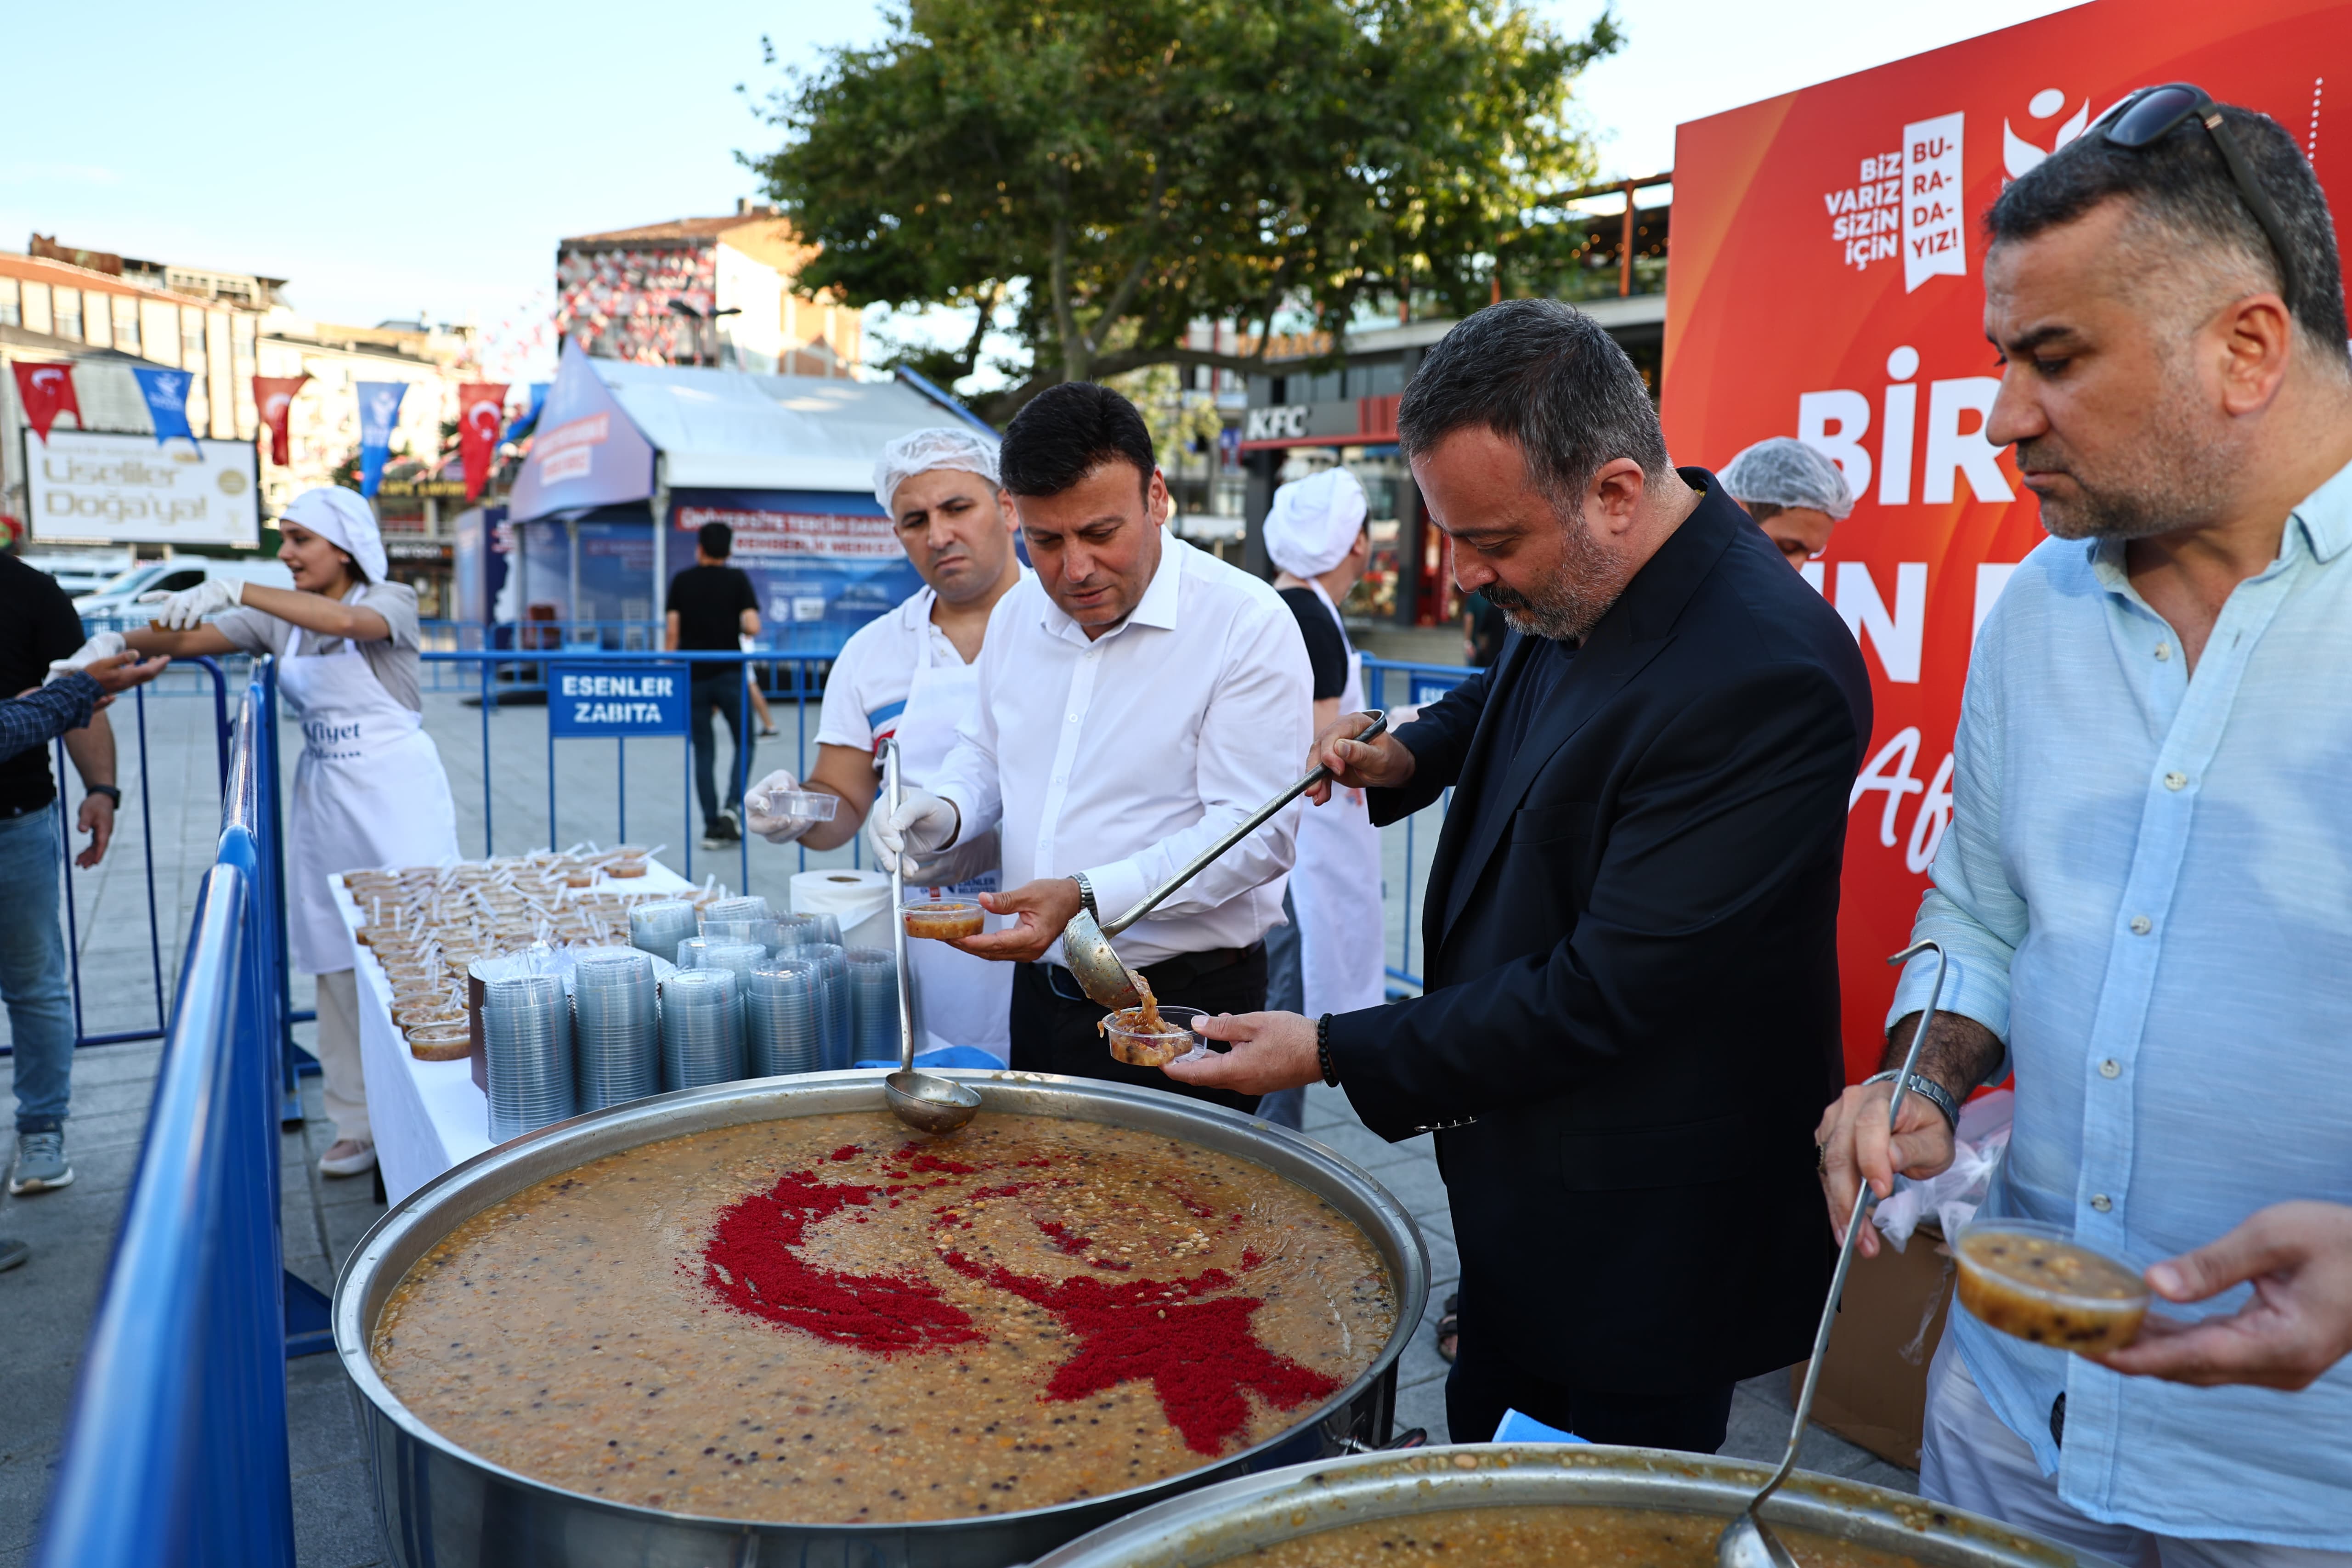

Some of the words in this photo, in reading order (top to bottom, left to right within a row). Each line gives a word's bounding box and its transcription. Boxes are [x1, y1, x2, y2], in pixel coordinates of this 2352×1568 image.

[1912, 137, 1953, 165] BU-
[1824, 178, 1901, 216] VARIZ
[1913, 170, 1952, 197] RA-
[1913, 201, 1953, 228] DA-
[1912, 227, 1957, 260] YIZ!
[1246, 405, 1308, 440] KFC
[562, 675, 673, 697] ESENLER
[574, 702, 662, 723] ZABITA
